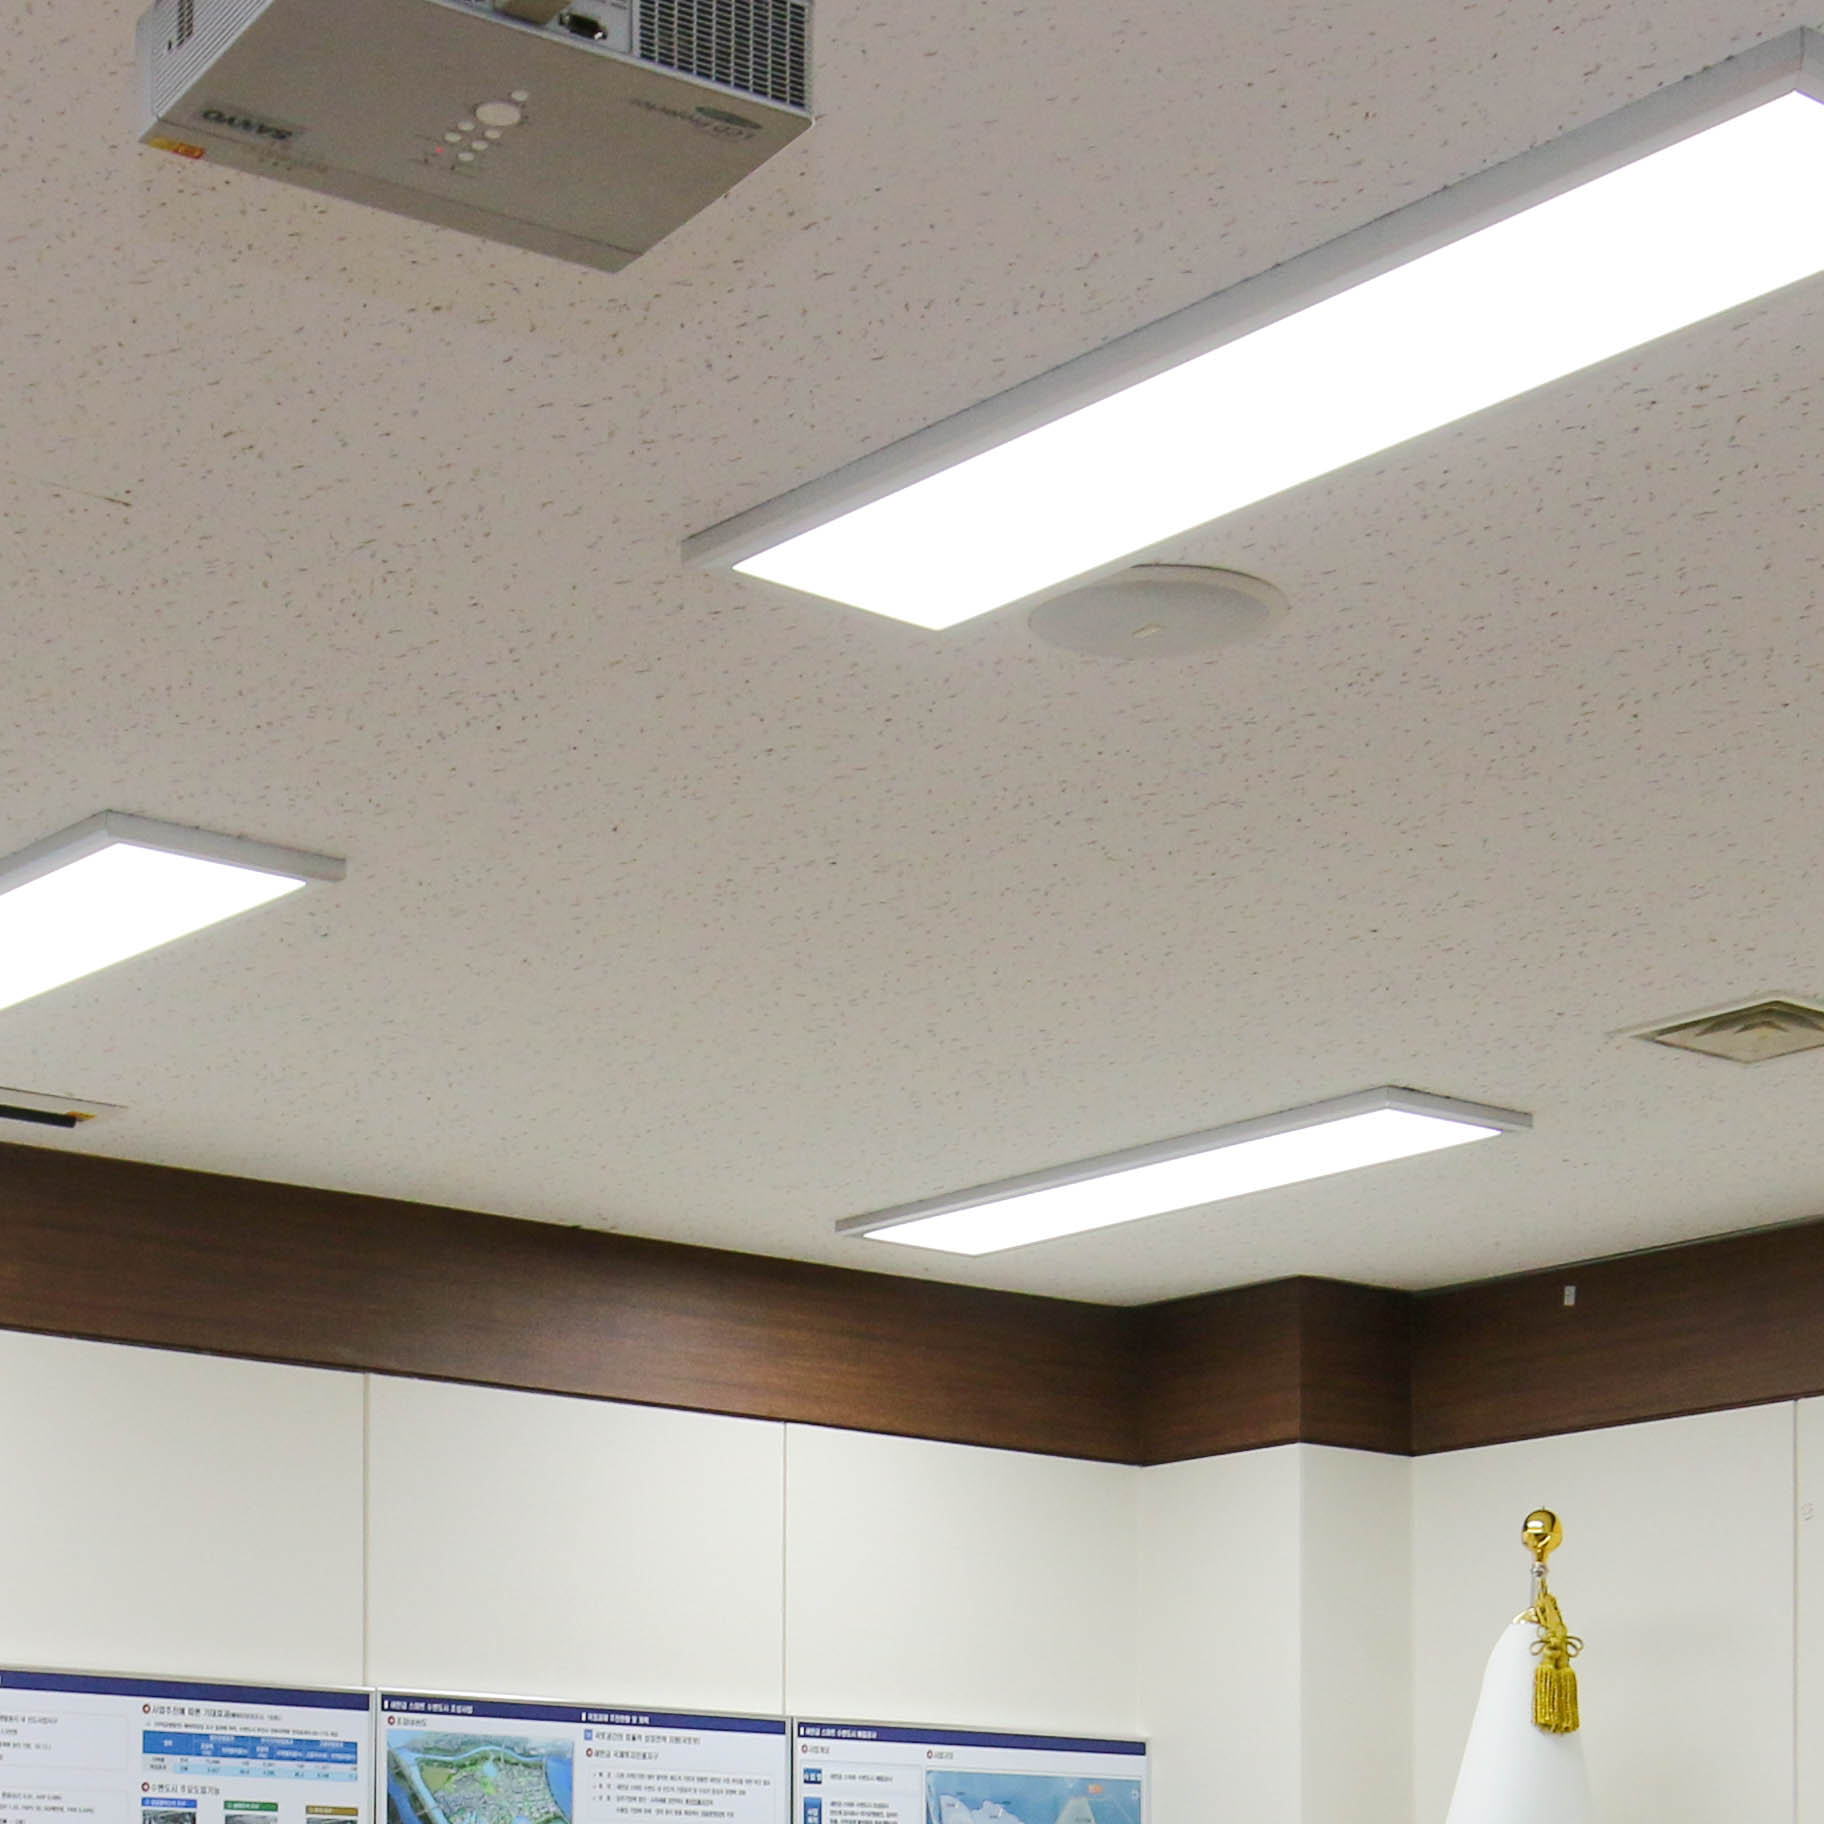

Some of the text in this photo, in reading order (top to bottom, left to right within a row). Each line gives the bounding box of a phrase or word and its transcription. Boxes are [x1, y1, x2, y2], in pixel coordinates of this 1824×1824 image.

[389, 1700, 408, 1711] 새만금
[408, 1701, 426, 1712] 스마트
[151, 1783, 178, 1794] 수변도시
